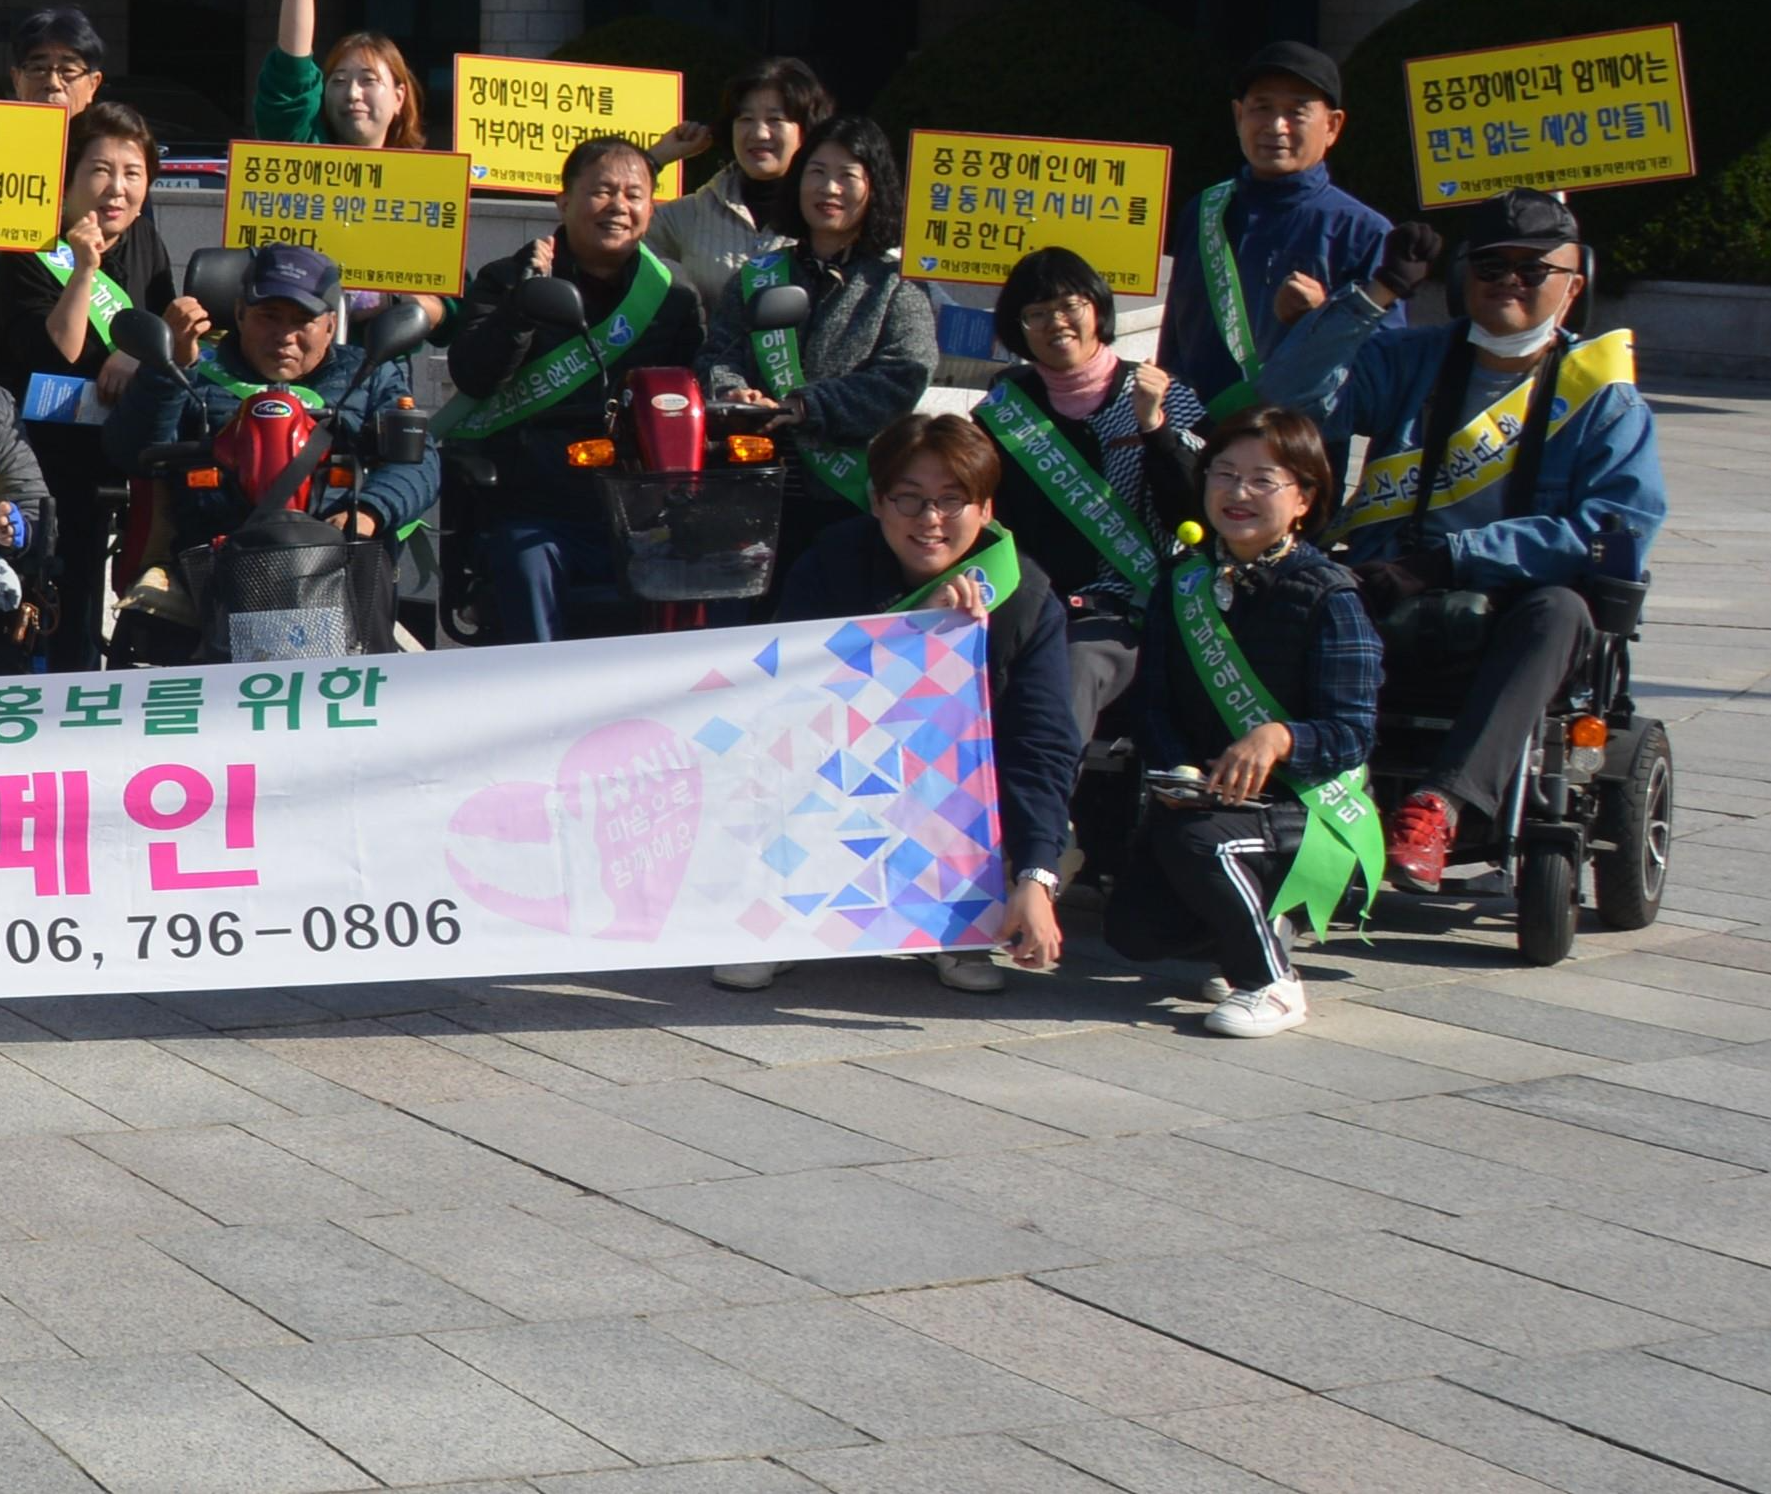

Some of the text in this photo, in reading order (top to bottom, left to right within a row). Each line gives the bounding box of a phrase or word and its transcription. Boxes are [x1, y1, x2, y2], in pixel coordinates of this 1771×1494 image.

[469, 76, 614, 116] 장애인의 승차를
[1422, 51, 1668, 114] 중증장애인과 함께하는
[469, 117, 544, 151] 거부하면
[1427, 100, 1671, 162] 편견 없는 세상 만들기
[244, 156, 383, 189] 중증장애인에게
[933, 147, 1126, 187] 중증장애인에게
[241, 190, 457, 229] 자립생활을 위한 프로그램을
[930, 182, 1148, 225] 활동지원서비스를
[925, 219, 1034, 252] 제공한다.
[238, 666, 388, 732] 위한
[125, 897, 462, 961] 796-0806
